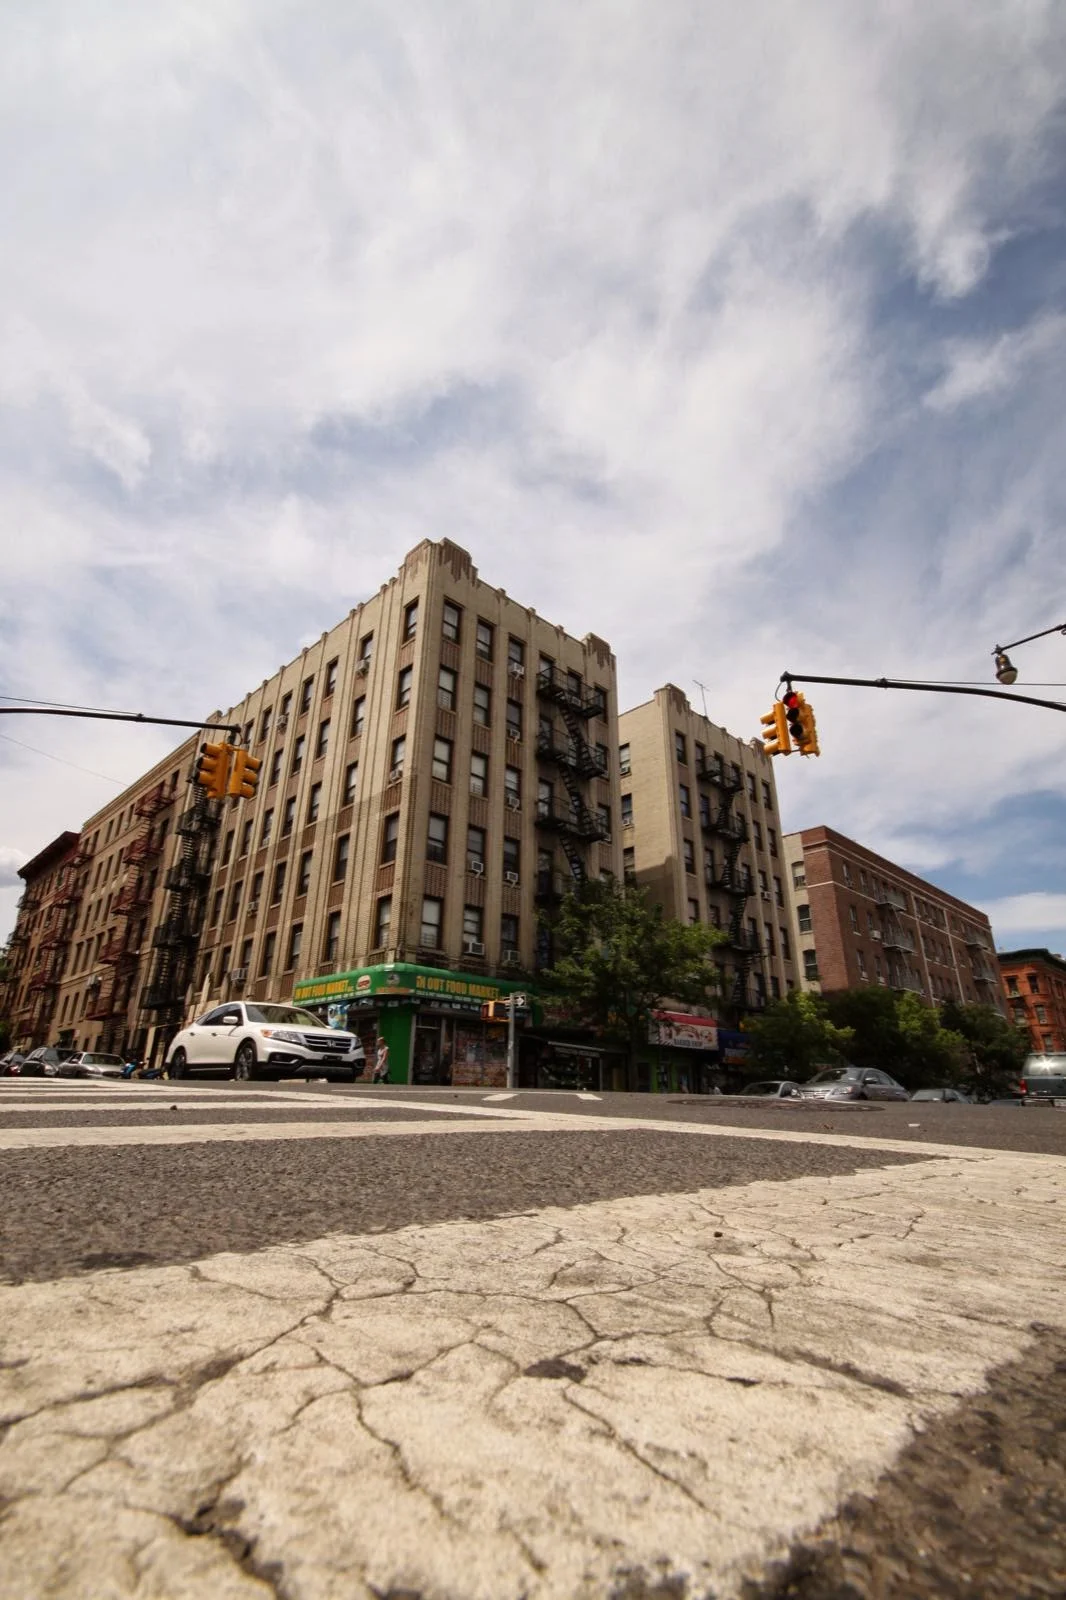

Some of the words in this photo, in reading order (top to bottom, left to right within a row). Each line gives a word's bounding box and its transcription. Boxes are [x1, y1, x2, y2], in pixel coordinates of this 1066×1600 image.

[427, 977, 445, 990] OUT
[446, 980, 467, 994] FOOD
[469, 983, 499, 998] MARKET
